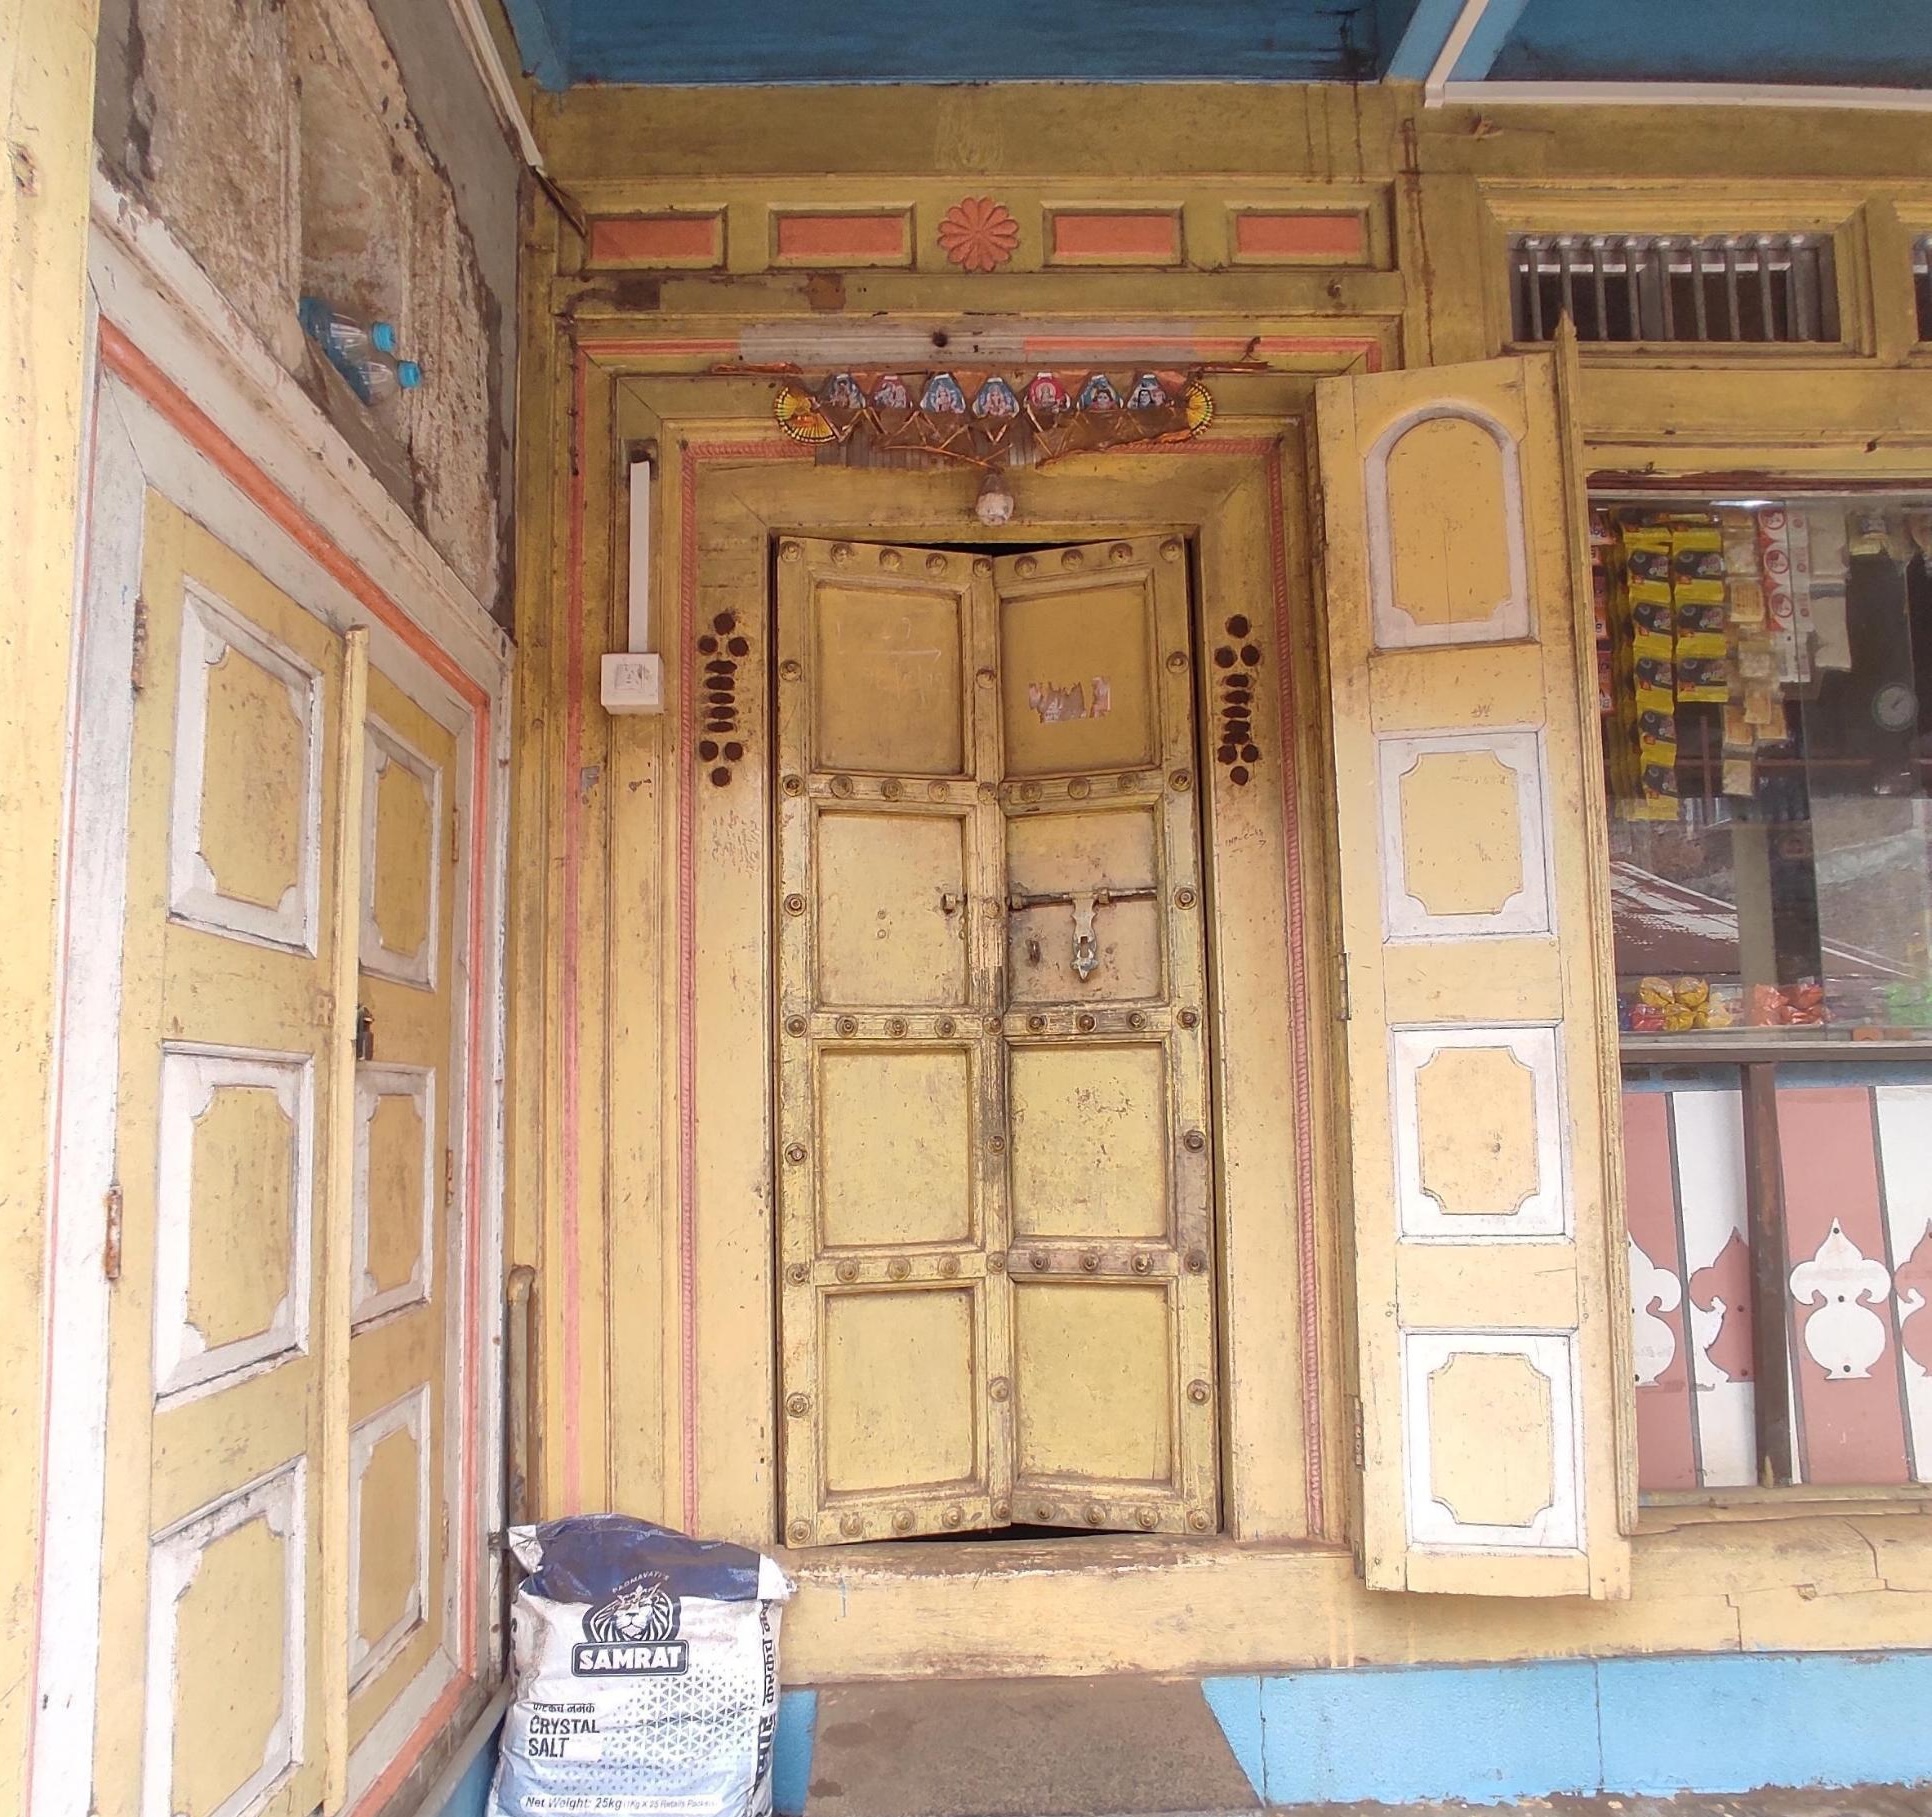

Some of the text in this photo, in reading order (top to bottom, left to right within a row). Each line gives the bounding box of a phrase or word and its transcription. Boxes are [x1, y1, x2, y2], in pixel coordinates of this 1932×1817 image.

[579, 1646, 682, 1670] SAMRAT
[529, 1715, 600, 1734] CRYSTAL
[528, 1737, 570, 1758] SALT
[525, 1797, 545, 1808] Net
[595, 1797, 622, 1811] 25kg
